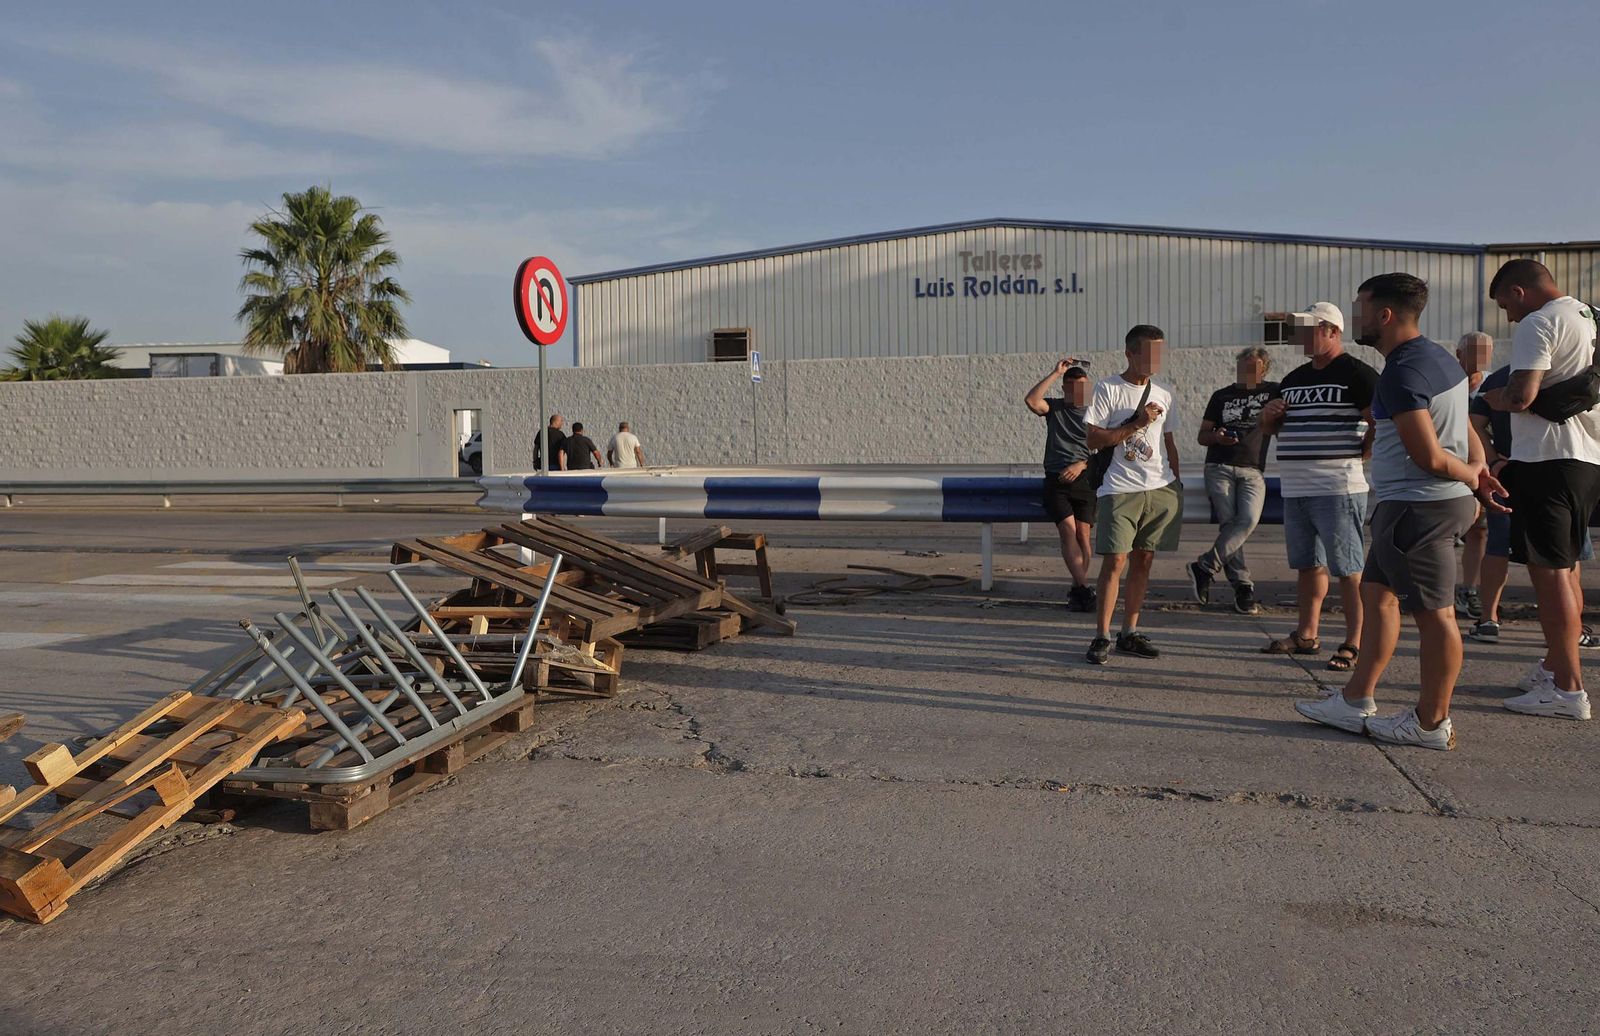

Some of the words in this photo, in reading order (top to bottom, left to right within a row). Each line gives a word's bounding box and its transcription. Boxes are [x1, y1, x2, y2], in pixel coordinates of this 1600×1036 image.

[959, 250, 1043, 272] Talleres
[914, 277, 955, 298] Luis
[963, 274, 1047, 299] Roldán,
[1054, 272, 1084, 295] s.l.
